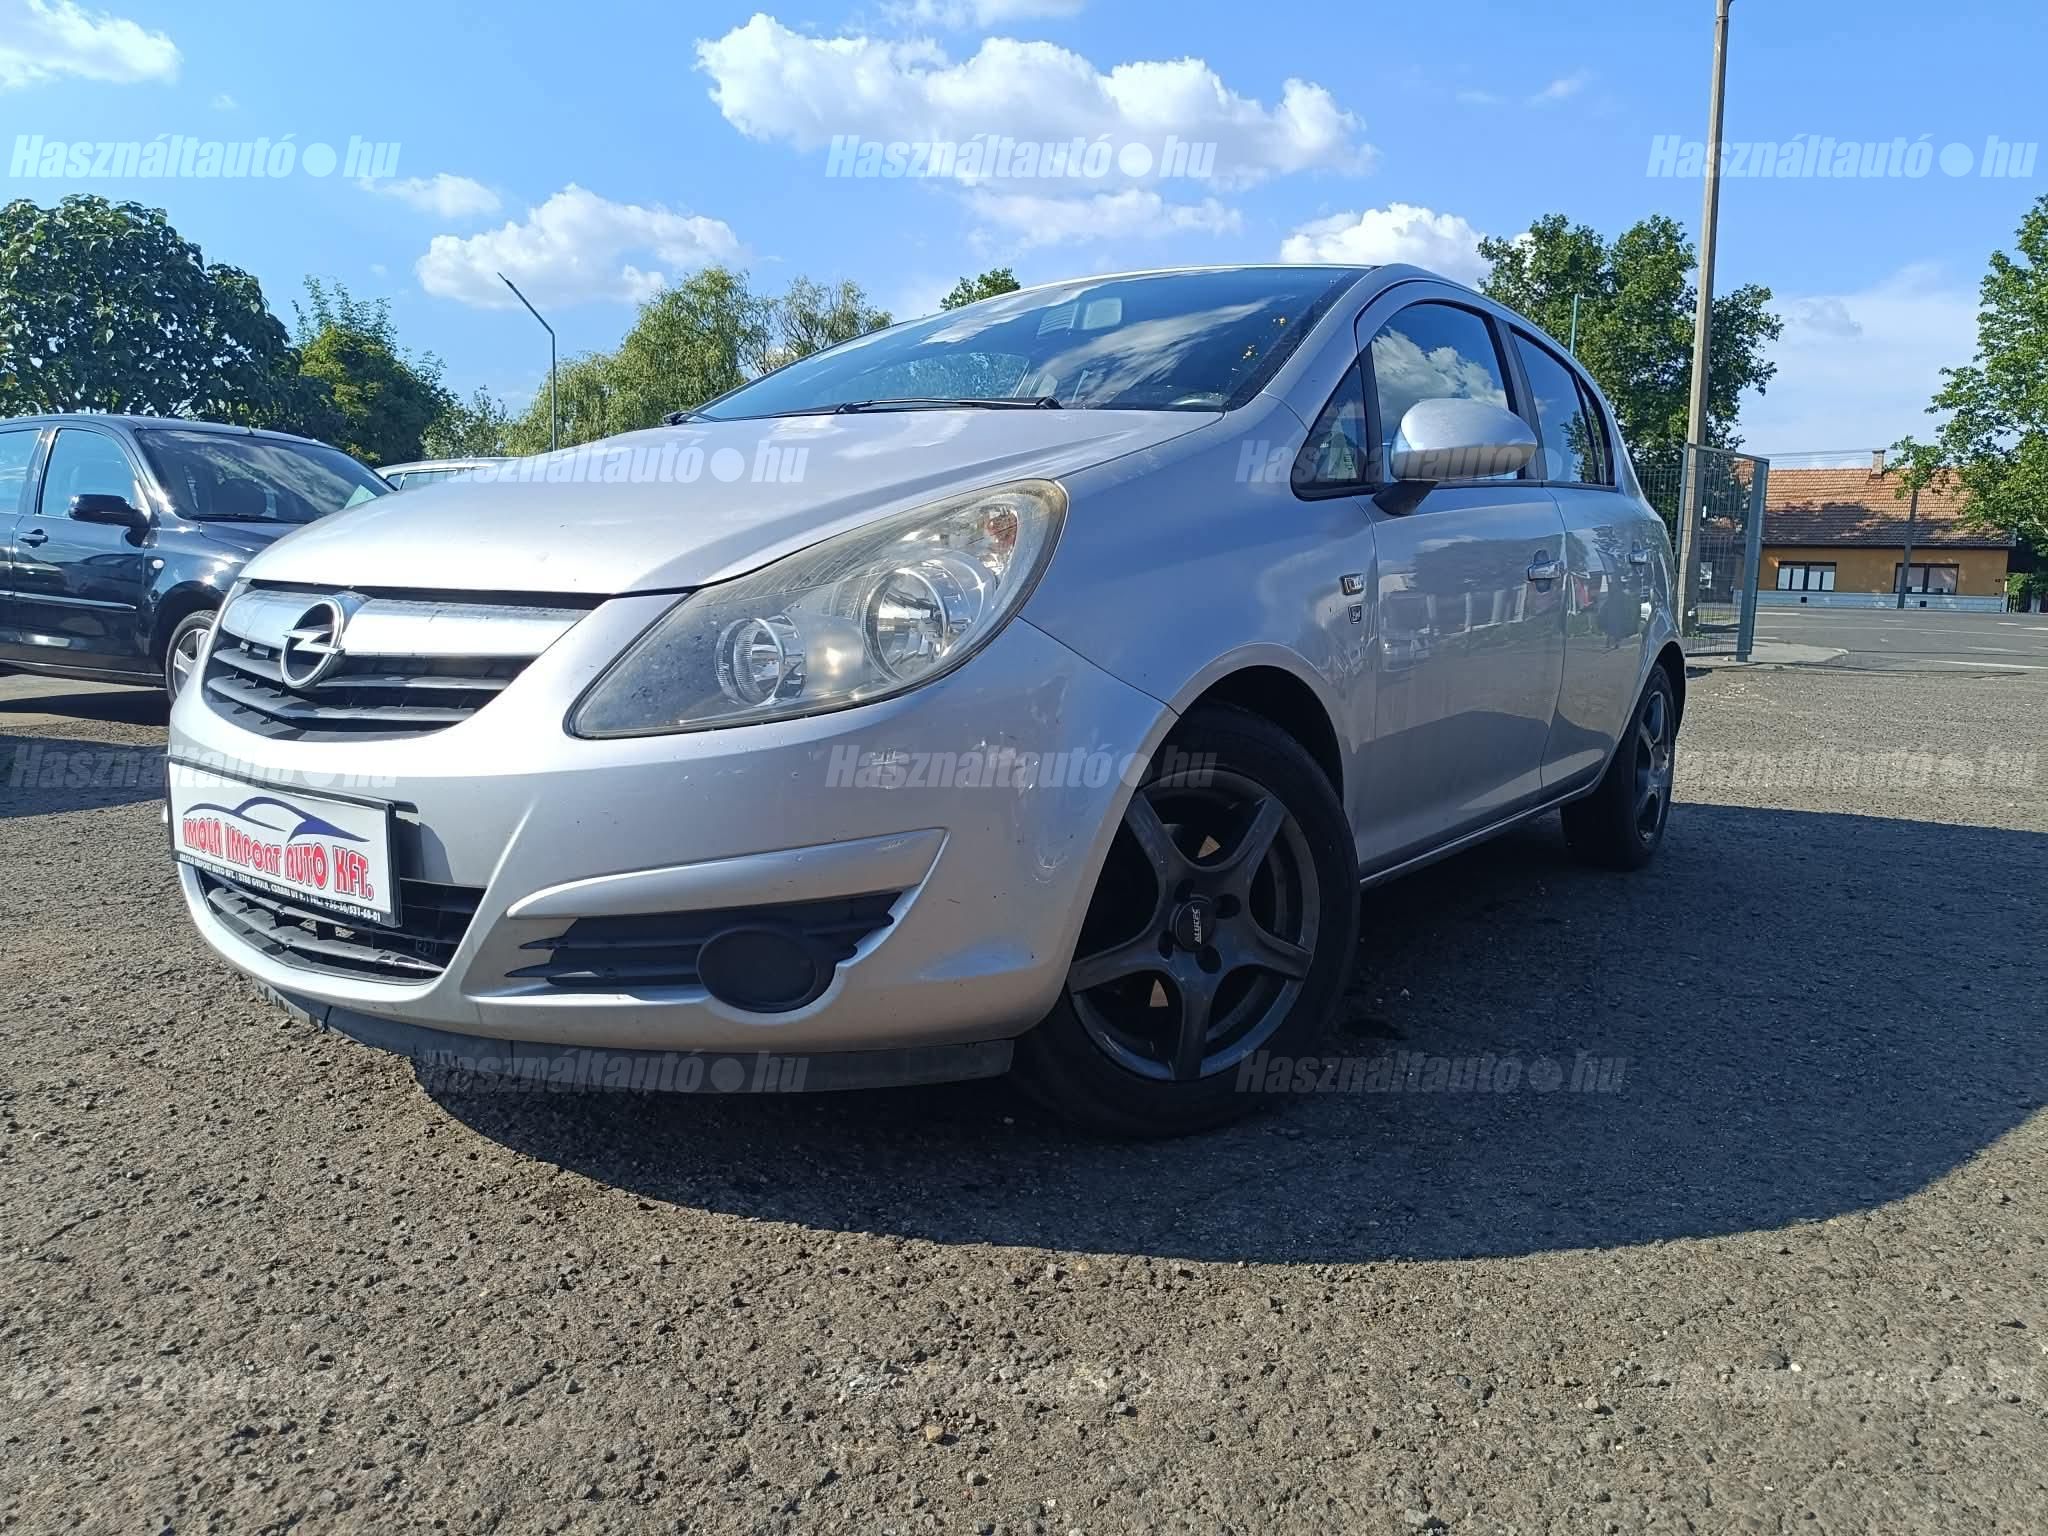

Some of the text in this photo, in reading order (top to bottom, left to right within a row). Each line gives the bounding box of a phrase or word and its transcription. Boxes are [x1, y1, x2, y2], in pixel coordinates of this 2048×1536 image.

[183, 817, 374, 901] IMOLA IMPORT AUTO KFT.
[1191, 906, 1201, 944] ALUTEC
